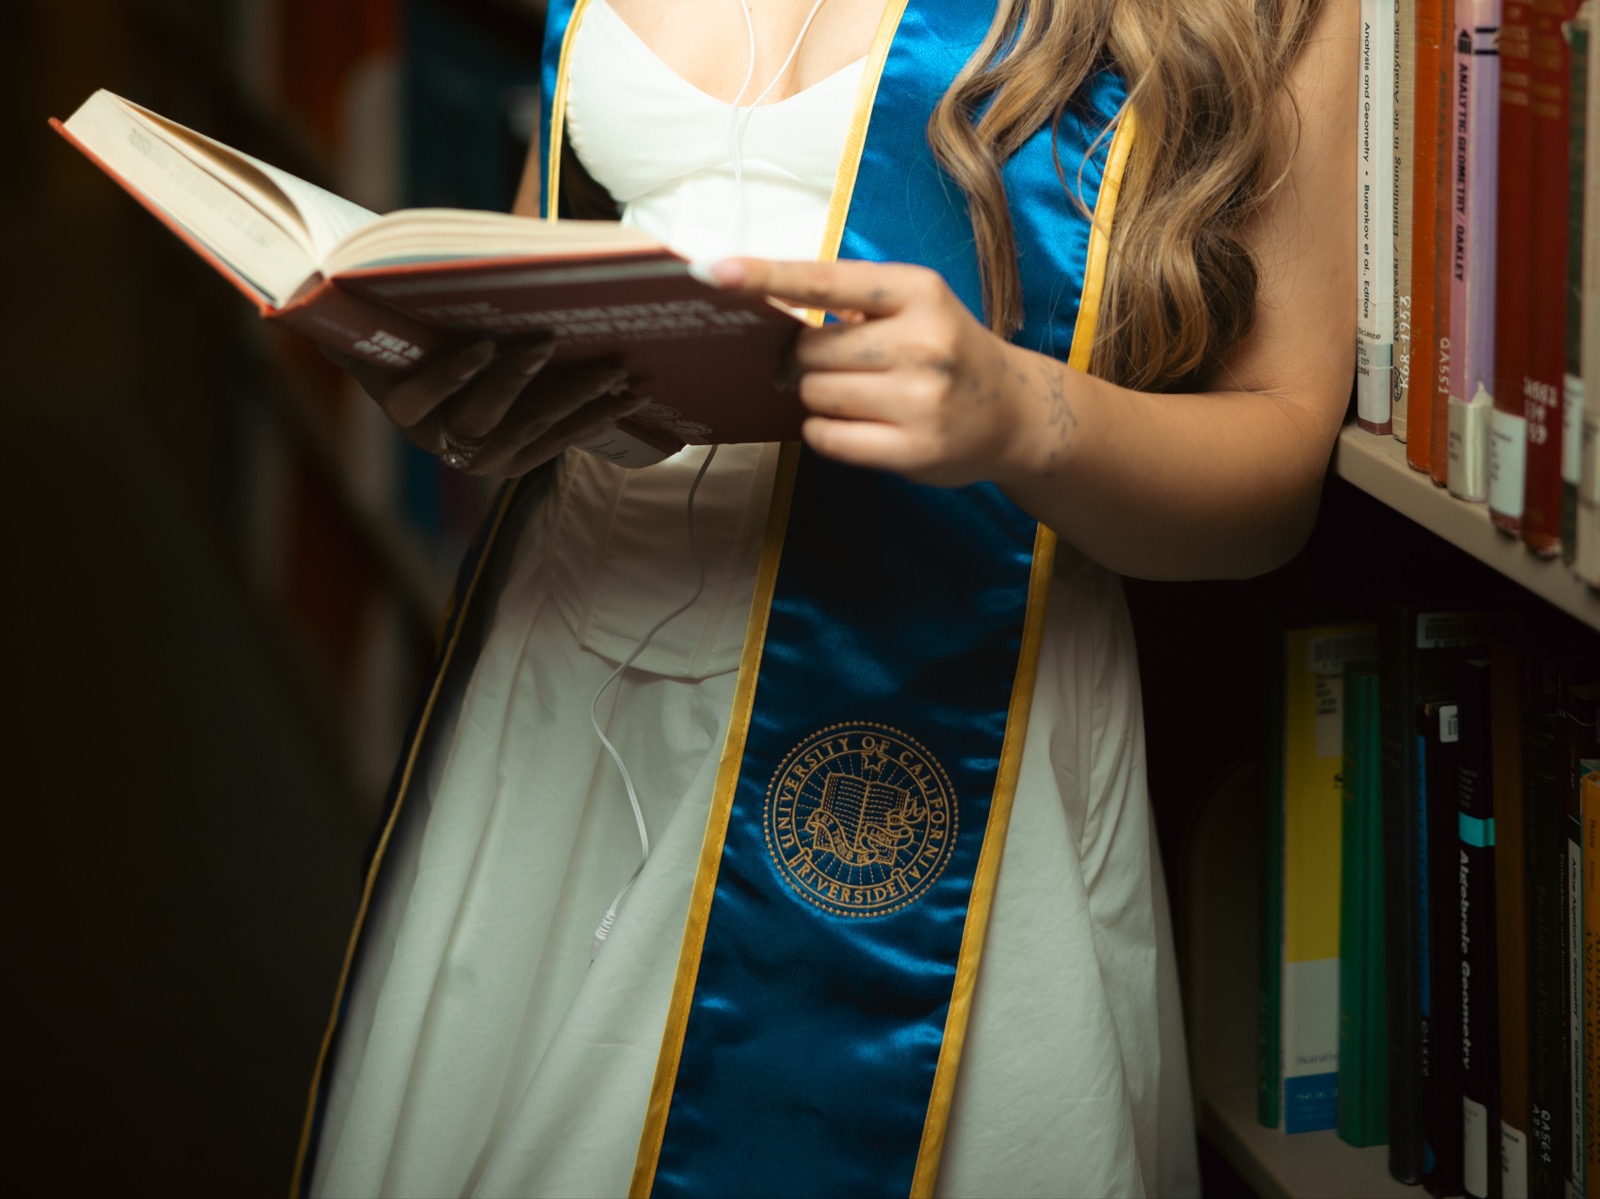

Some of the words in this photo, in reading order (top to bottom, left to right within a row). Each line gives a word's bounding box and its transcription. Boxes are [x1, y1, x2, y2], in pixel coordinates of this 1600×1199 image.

[1363, 22, 1371, 70] Analysis
[1457, 63, 1469, 133] ANALYTIC
[1363, 102, 1371, 162] Geometry
[1456, 136, 1467, 215] GEOMETRY
[1363, 184, 1371, 240] Burenkov
[1363, 243, 1370, 256] et
[1454, 225, 1465, 282] OAKLEY
[1438, 337, 1451, 395] QA551
[777, 737, 850, 849] UNIVERSITY
[861, 736, 891, 751] OF
[900, 750, 945, 881] CALIFORNIA
[869, 827, 900, 848] LIGHT
[796, 862, 901, 904] RIVERSIDE
[1459, 848, 1471, 955] Algebraic
[1535, 885, 1548, 971] Resolution
[1461, 960, 1473, 1071] Geometry
[1586, 1017, 1595, 1167] APPLICATIONS
[1540, 1109, 1551, 1165] QA564
